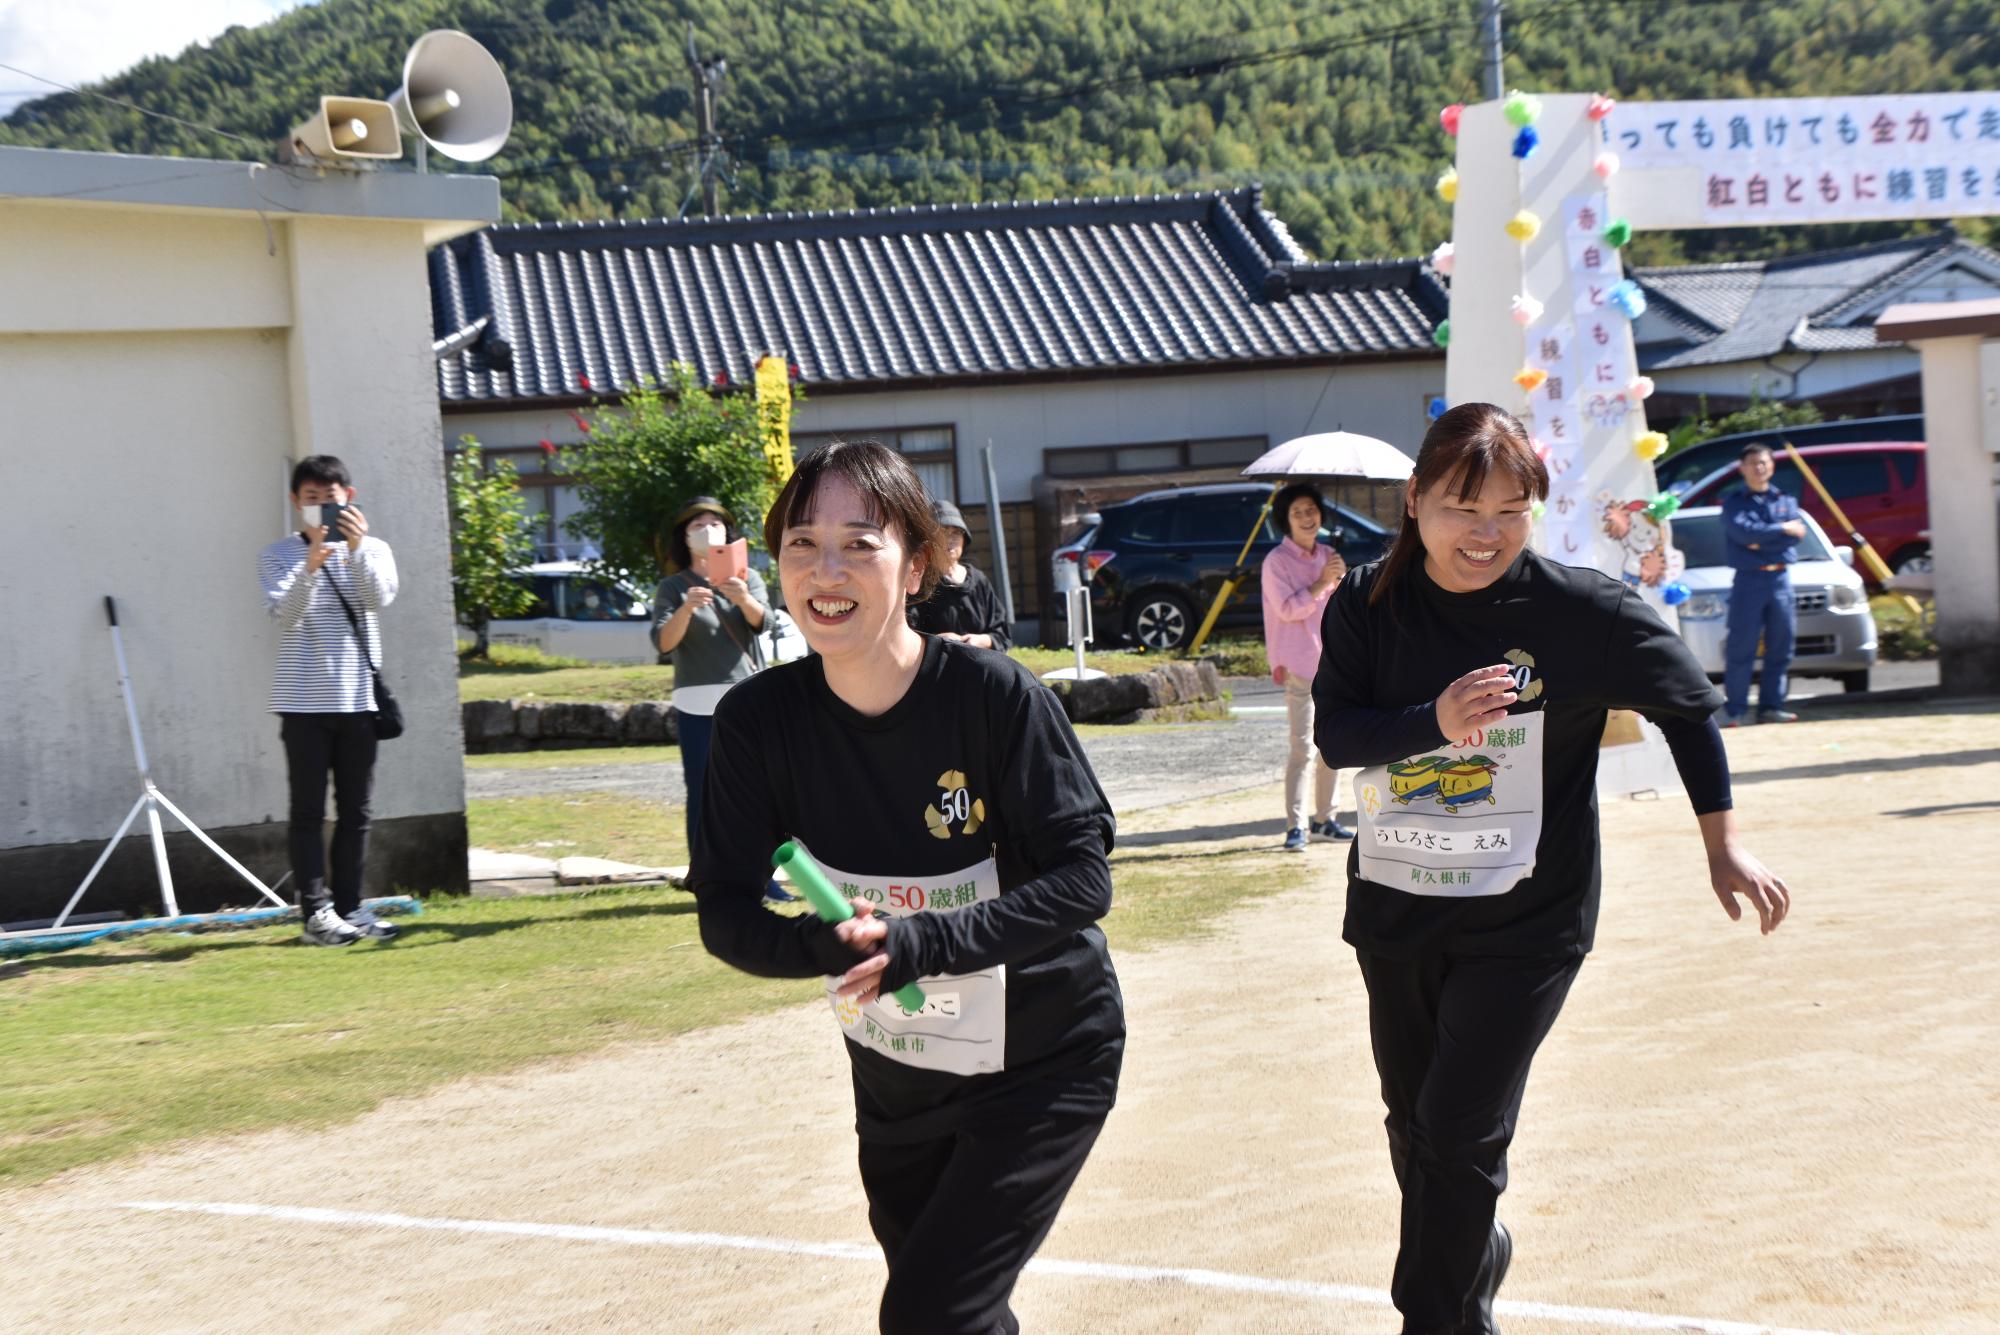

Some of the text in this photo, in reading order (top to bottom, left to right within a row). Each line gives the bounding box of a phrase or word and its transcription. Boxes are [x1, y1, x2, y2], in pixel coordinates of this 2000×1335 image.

[1601, 107, 2000, 149] っても負けても全力で走
[1708, 166, 2000, 207] 紅白ともに練習を
[940, 787, 970, 825] 50
[1377, 829, 1508, 851] うしろさこ えみ
[1410, 868, 1472, 886] 阿久根市
[865, 1020, 926, 1053] 阿久根市
